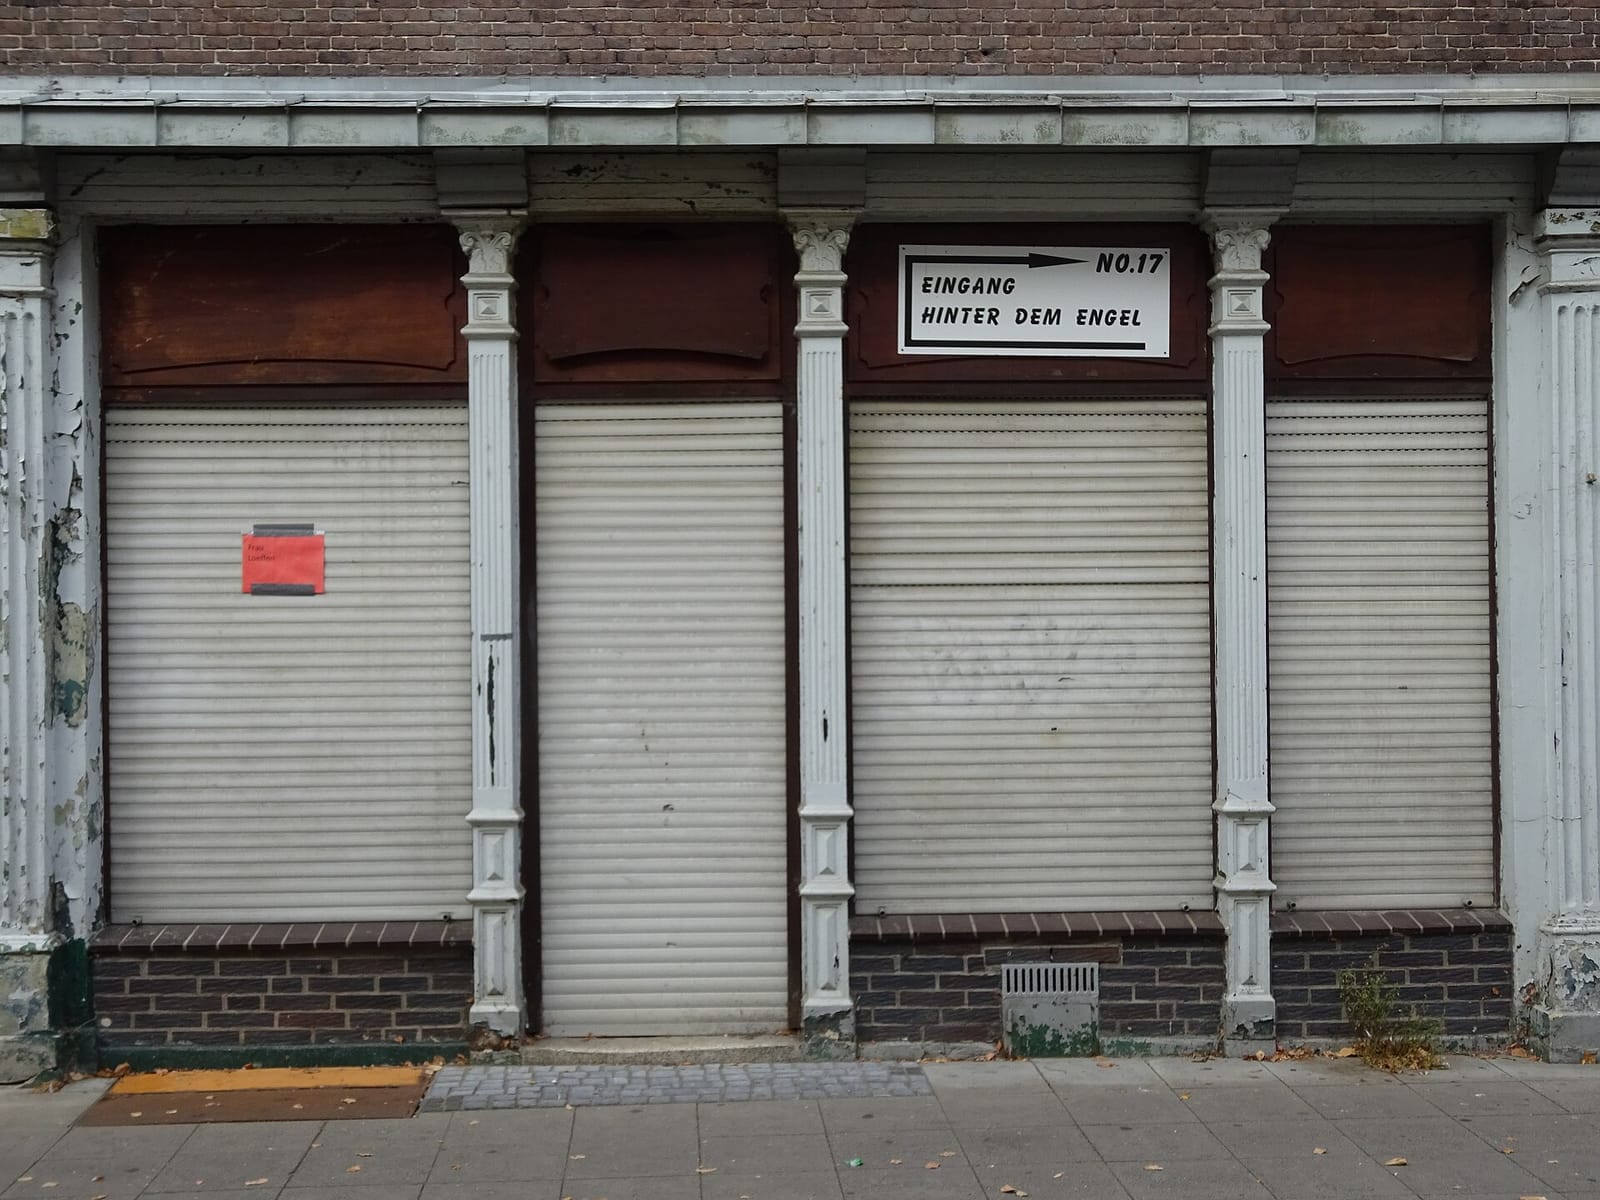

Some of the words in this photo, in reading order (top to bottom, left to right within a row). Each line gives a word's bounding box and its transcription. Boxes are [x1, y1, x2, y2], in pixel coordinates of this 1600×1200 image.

[1096, 252, 1164, 274] NO.17
[921, 276, 1016, 295] EINGANG
[921, 307, 1000, 326] HINTER
[1015, 308, 1062, 326] DEM
[1076, 308, 1141, 327] ENGEL
[247, 543, 265, 552] Frau
